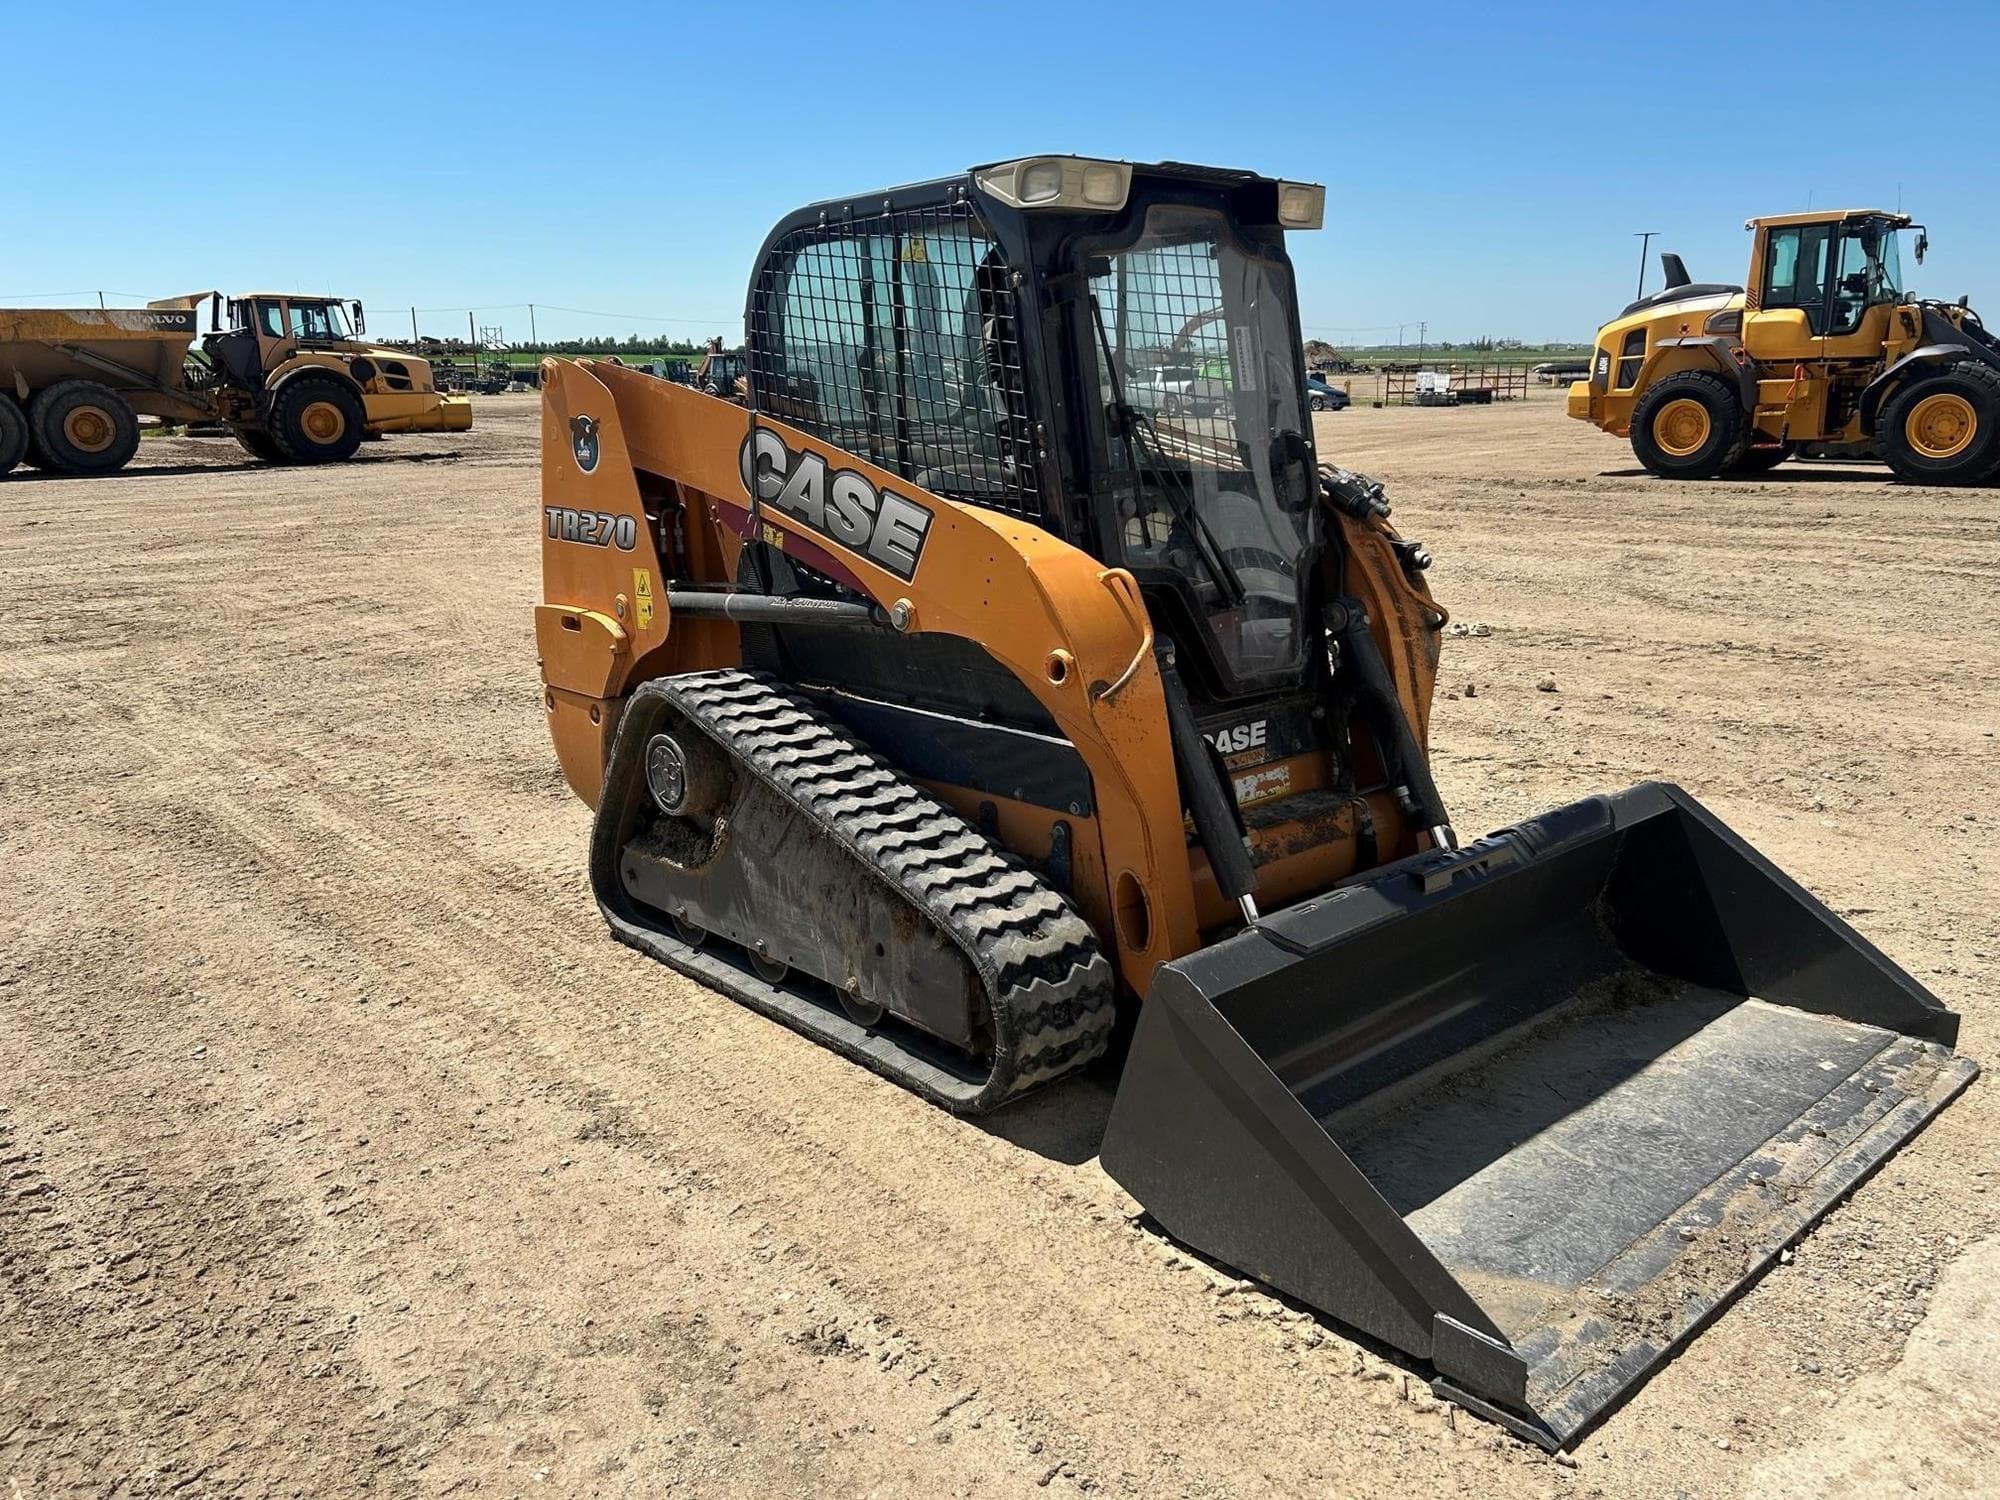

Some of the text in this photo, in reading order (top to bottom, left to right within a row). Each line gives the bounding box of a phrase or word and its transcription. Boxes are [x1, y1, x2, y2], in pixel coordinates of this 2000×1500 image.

[1598, 357, 1608, 374] L60H
[741, 429, 933, 577] CASE
[545, 506, 637, 551] TR270
[1202, 720, 1267, 753] ASE
